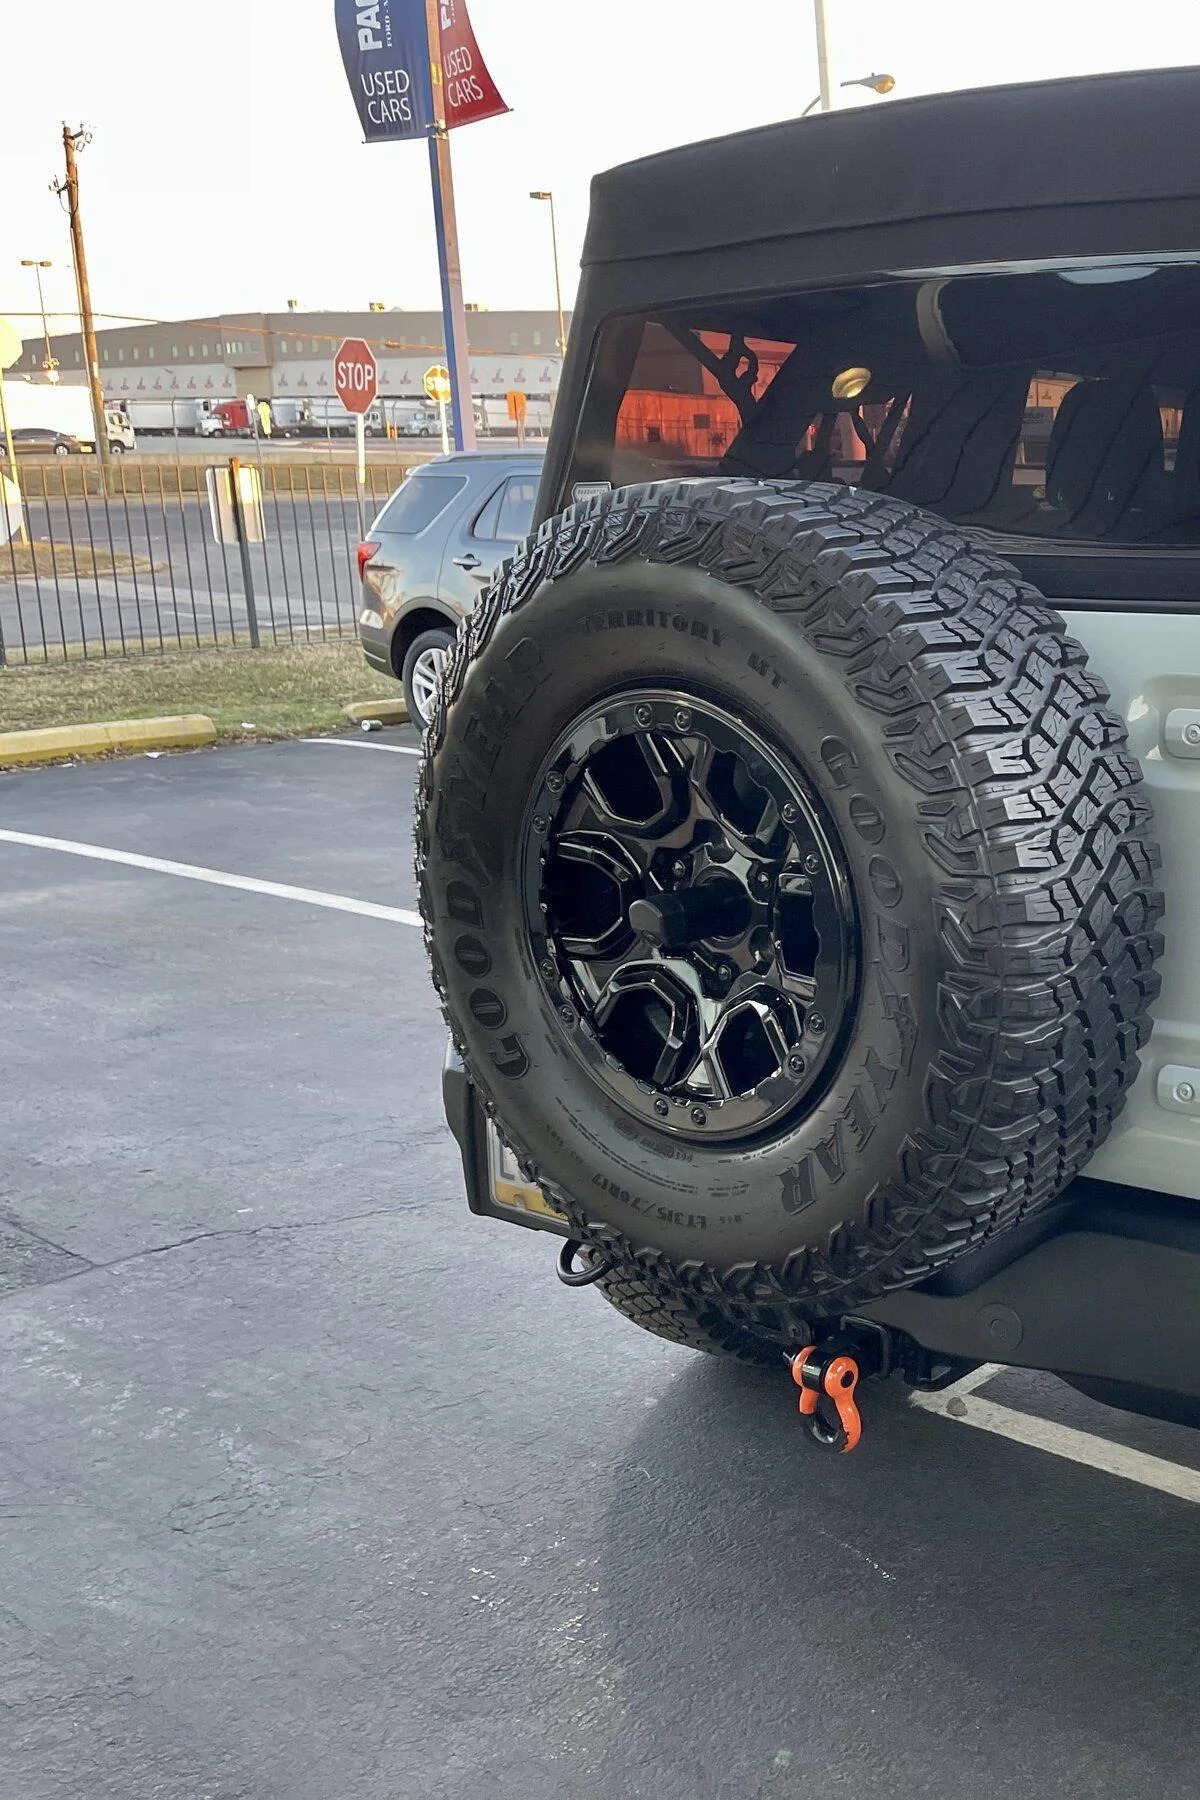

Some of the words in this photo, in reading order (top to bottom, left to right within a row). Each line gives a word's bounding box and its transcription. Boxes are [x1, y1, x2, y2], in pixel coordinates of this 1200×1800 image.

[443, 46, 473, 79] USED
[361, 70, 410, 97] USED
[448, 75, 484, 108] CARS
[367, 97, 411, 124] CARS
[338, 361, 374, 391] STOP
[577, 608, 727, 648] TERRITORY
[747, 652, 787, 690] MT
